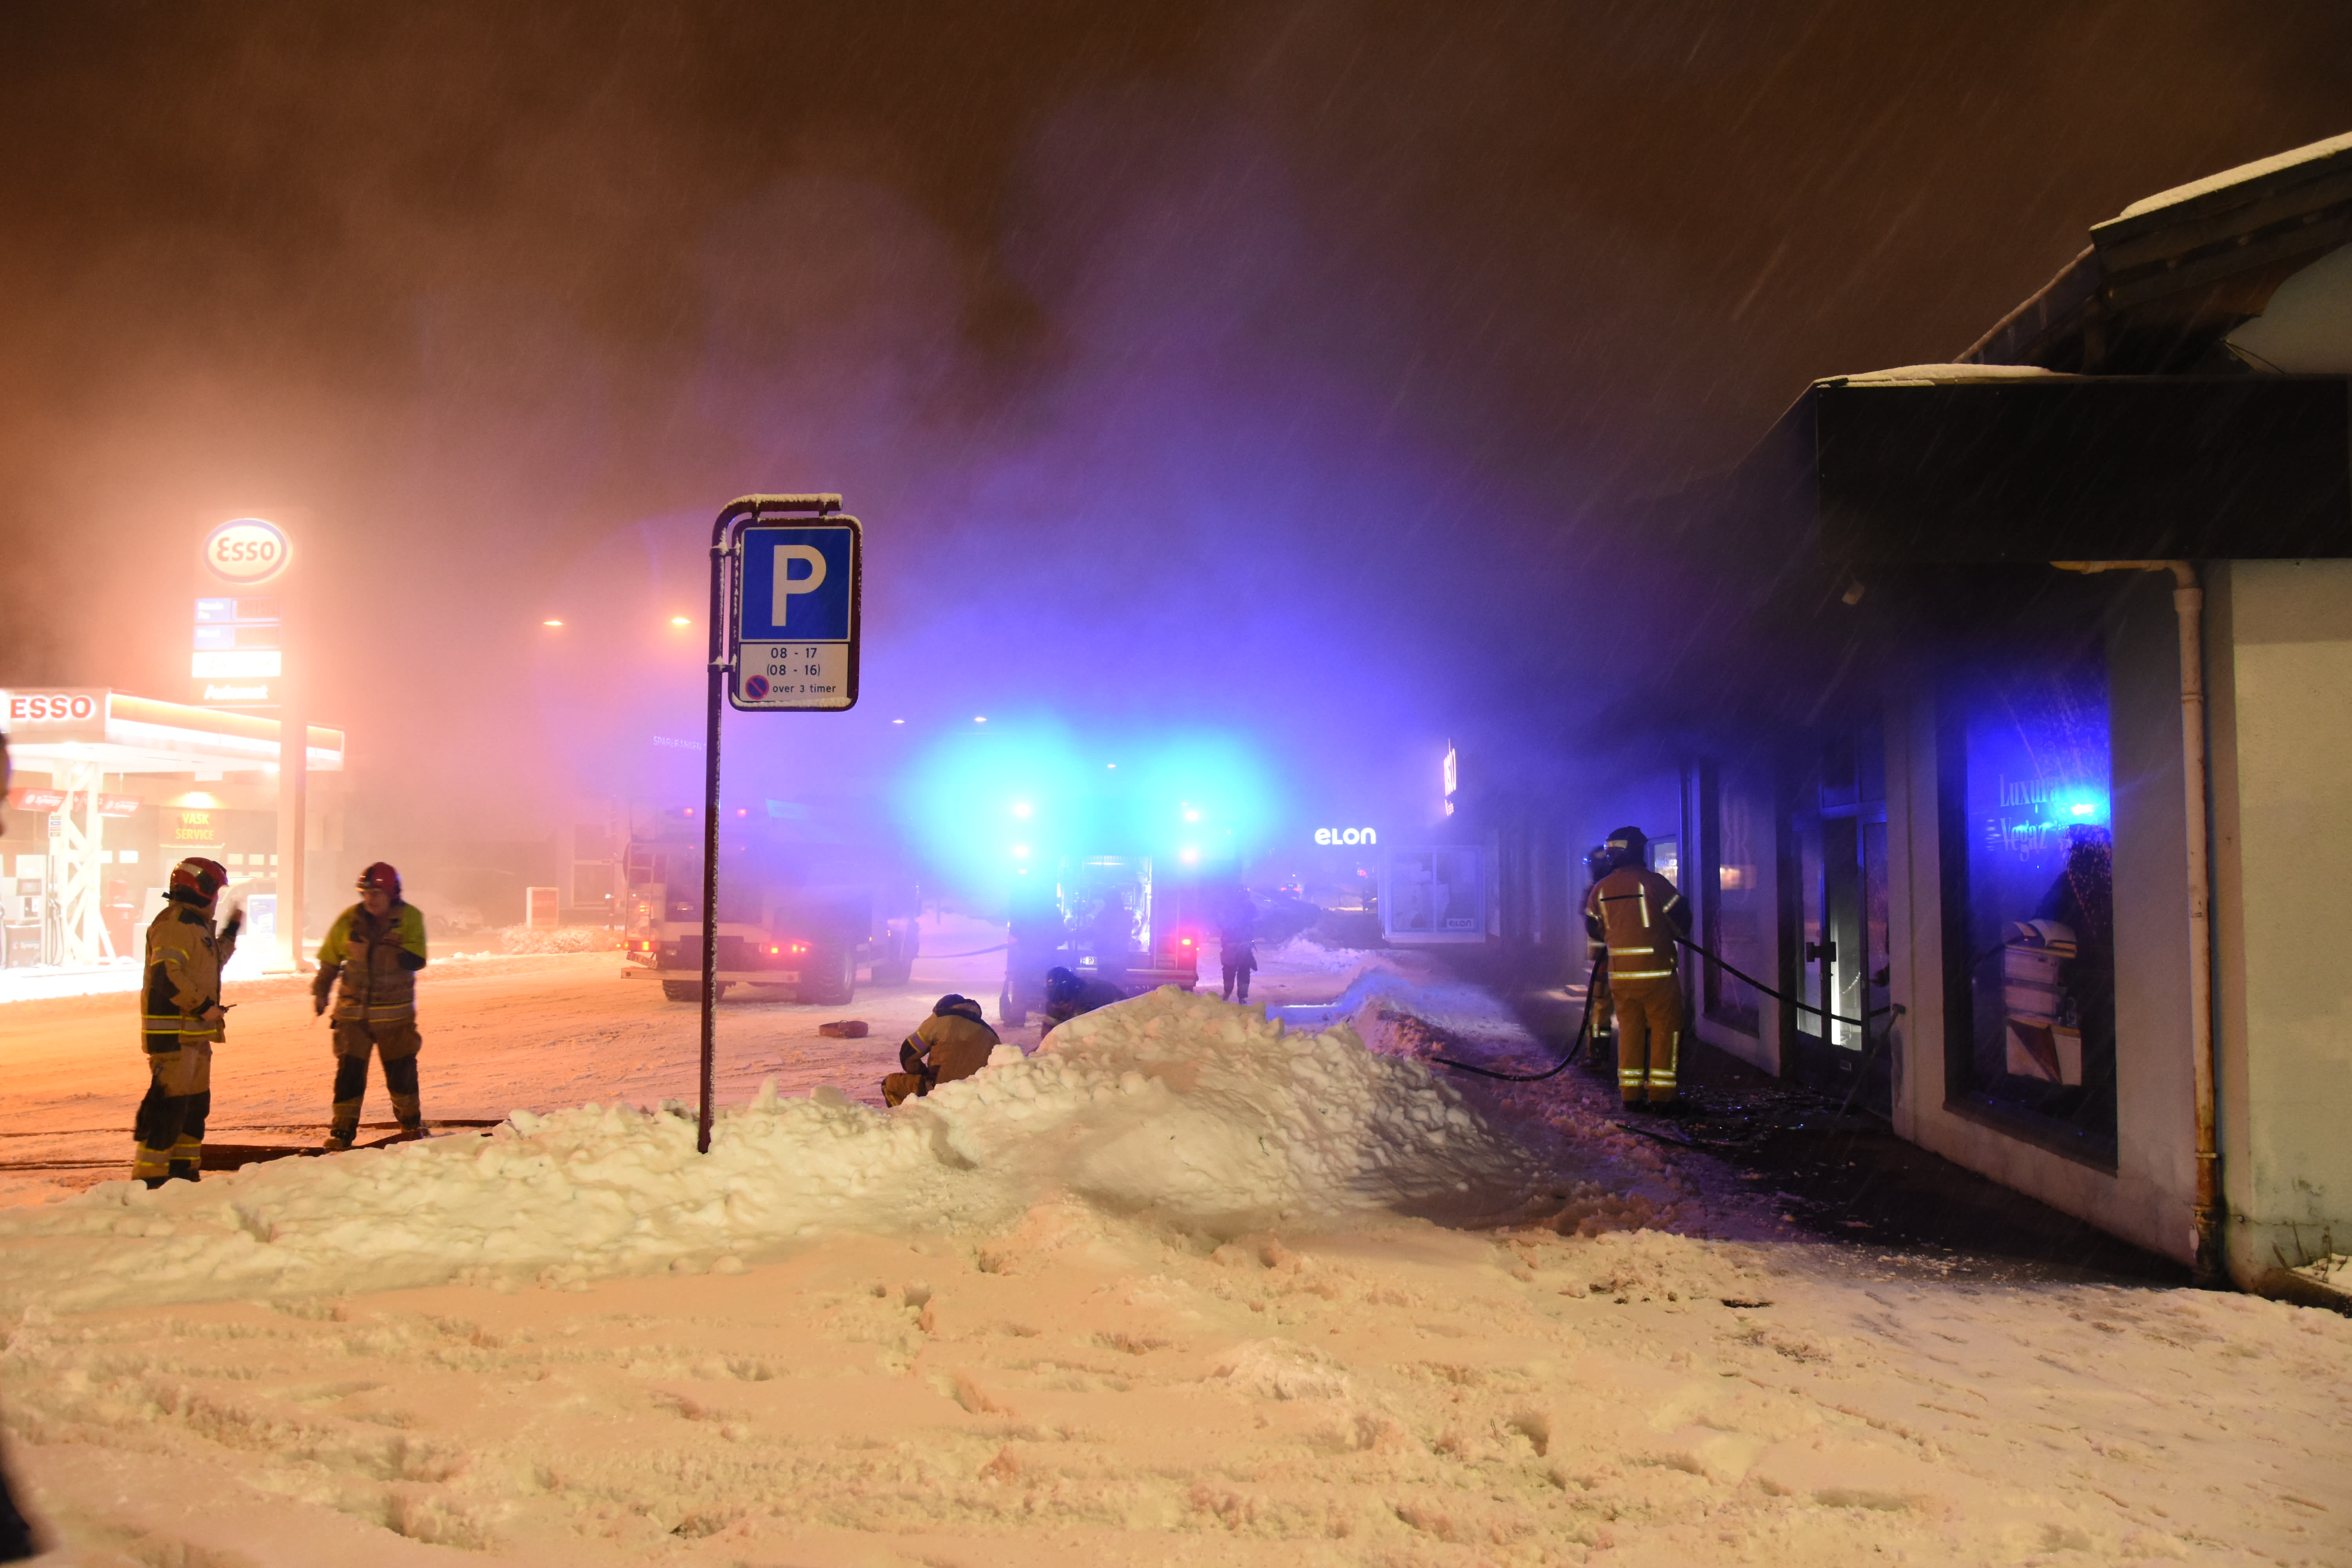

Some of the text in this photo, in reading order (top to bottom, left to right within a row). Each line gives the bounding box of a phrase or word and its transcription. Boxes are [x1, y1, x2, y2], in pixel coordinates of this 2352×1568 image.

[772, 545, 826, 626] P
[771, 648, 787, 658] 08
[806, 648, 817, 658] 17
[767, 664, 786, 676] (08
[805, 664, 820, 676] 16)
[809, 684, 836, 693] timer
[11, 697, 91, 719] ESSO
[182, 813, 210, 825] VASK
[176, 828, 214, 840] SERVICE
